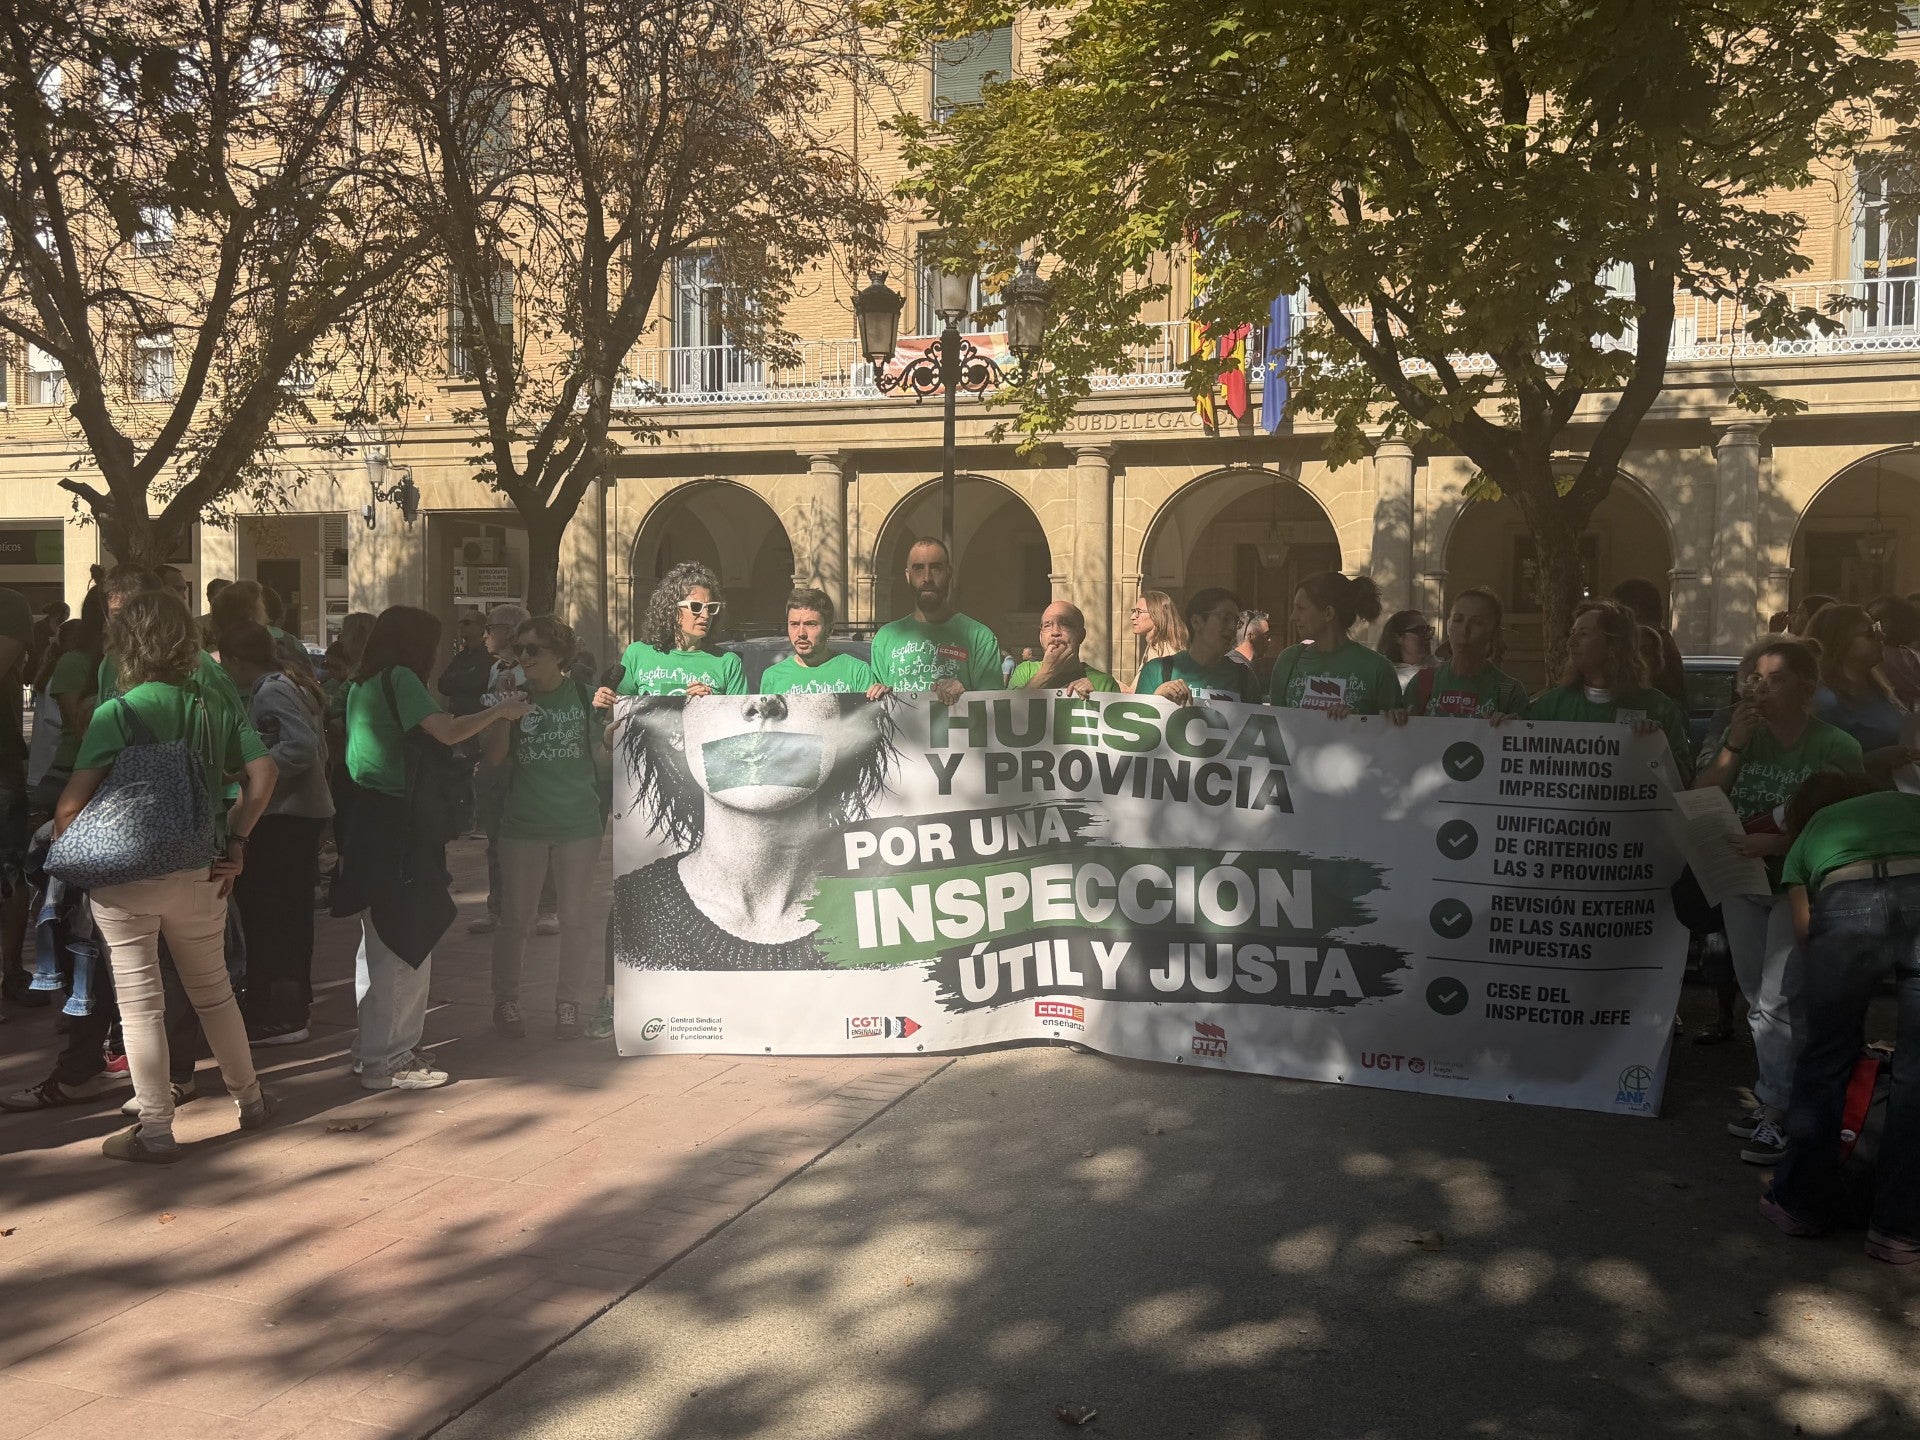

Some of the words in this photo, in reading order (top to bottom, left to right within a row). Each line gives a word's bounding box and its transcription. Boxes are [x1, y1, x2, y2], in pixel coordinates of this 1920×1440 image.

[1442, 695, 1462, 704] UGT
[928, 697, 1292, 767] HUESCA
[1502, 736, 1620, 756] ELIMINACIÓN
[1500, 757, 1524, 775] DE
[1529, 756, 1613, 779] MÍNIMOS
[924, 752, 966, 796] Y
[984, 749, 1295, 815] PROVINCIA
[1499, 779, 1658, 801] IMPRESCINDIBLES
[1496, 815, 1611, 837] UNIFICACIÓN
[843, 823, 956, 871] POR
[969, 806, 1073, 857] UNA
[1494, 837, 1518, 854] DE
[1523, 839, 1618, 859] CRITERIOS
[1623, 842, 1644, 859] EN
[1493, 859, 1527, 878] LAS
[1532, 862, 1545, 879] 3
[1551, 863, 1654, 881] PROVINCIAS
[853, 852, 1315, 950] INSPECCIÓN
[1491, 894, 1576, 916] REVISIÓN
[1581, 898, 1656, 917] EXTERNA
[1490, 917, 1513, 934] DE
[1519, 918, 1554, 936] LAS
[1559, 920, 1654, 939] SANCIONES
[1488, 937, 1592, 960] IMPUESTAS
[958, 938, 1085, 1004] ÚTIL
[1090, 940, 1133, 991] Y
[1149, 942, 1366, 999] JUSTA
[1486, 982, 1532, 1001] CESE
[1537, 985, 1571, 1004] DEL
[670, 1016, 695, 1024] Central
[1038, 1004, 1073, 1017] CCOO
[1485, 1003, 1584, 1026] INSPECTOR
[1589, 1009, 1631, 1026] JEFE
[645, 1024, 666, 1034] CSIF
[670, 1025, 717, 1034] Independiente
[851, 1016, 880, 1028] CGT
[1193, 1039, 1227, 1053] STEA
[1361, 1051, 1406, 1072] UGT
